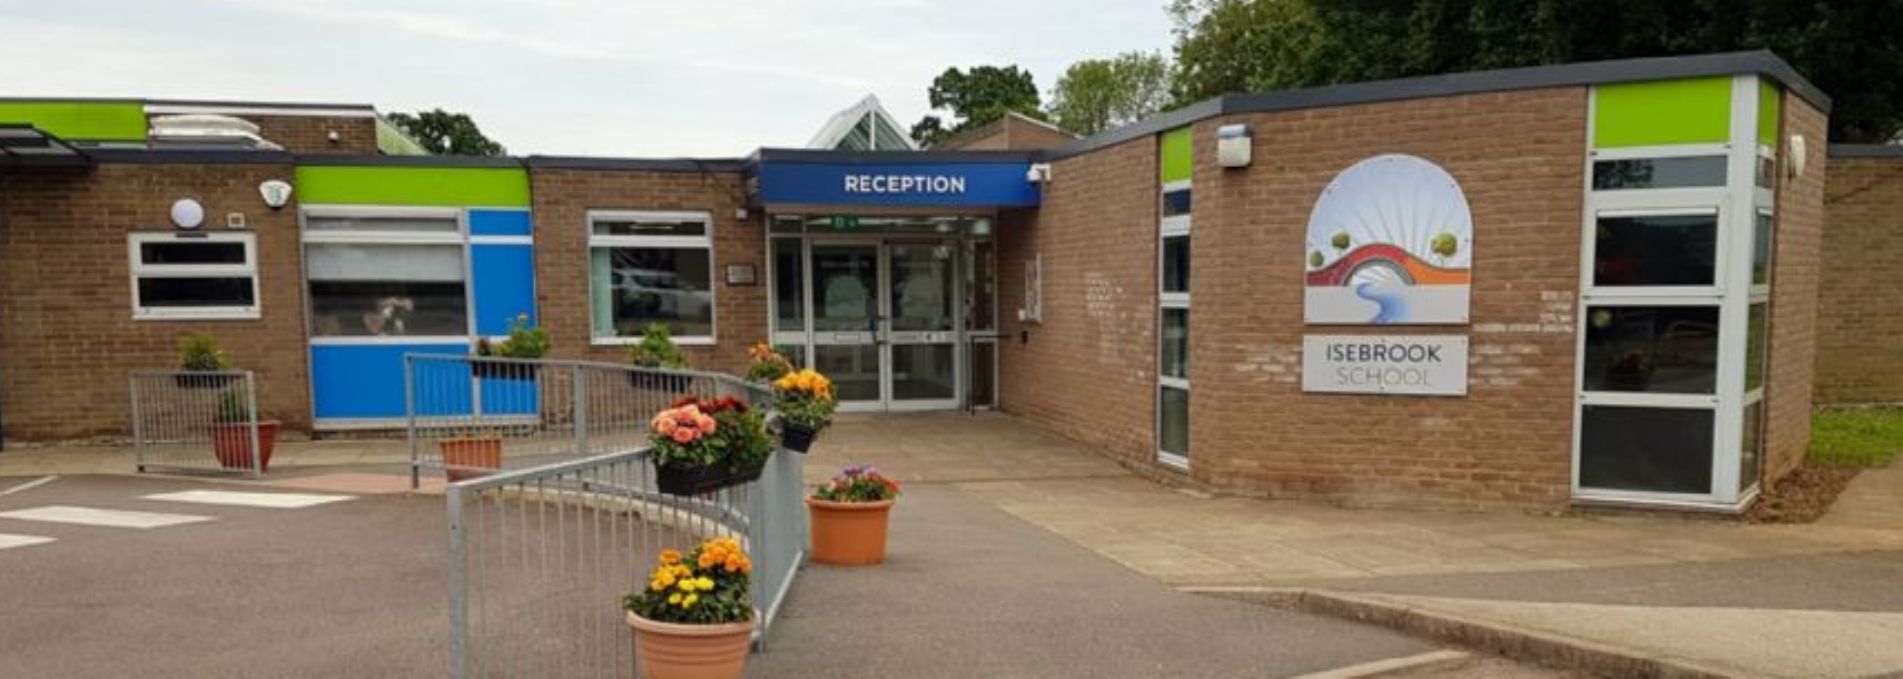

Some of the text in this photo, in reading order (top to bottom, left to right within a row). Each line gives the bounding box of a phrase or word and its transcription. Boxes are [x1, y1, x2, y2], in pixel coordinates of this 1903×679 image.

[844, 175, 966, 193] RECEPTION
[1326, 343, 1443, 363] ISEBROOK
[1336, 366, 1434, 387] SCHOOL
